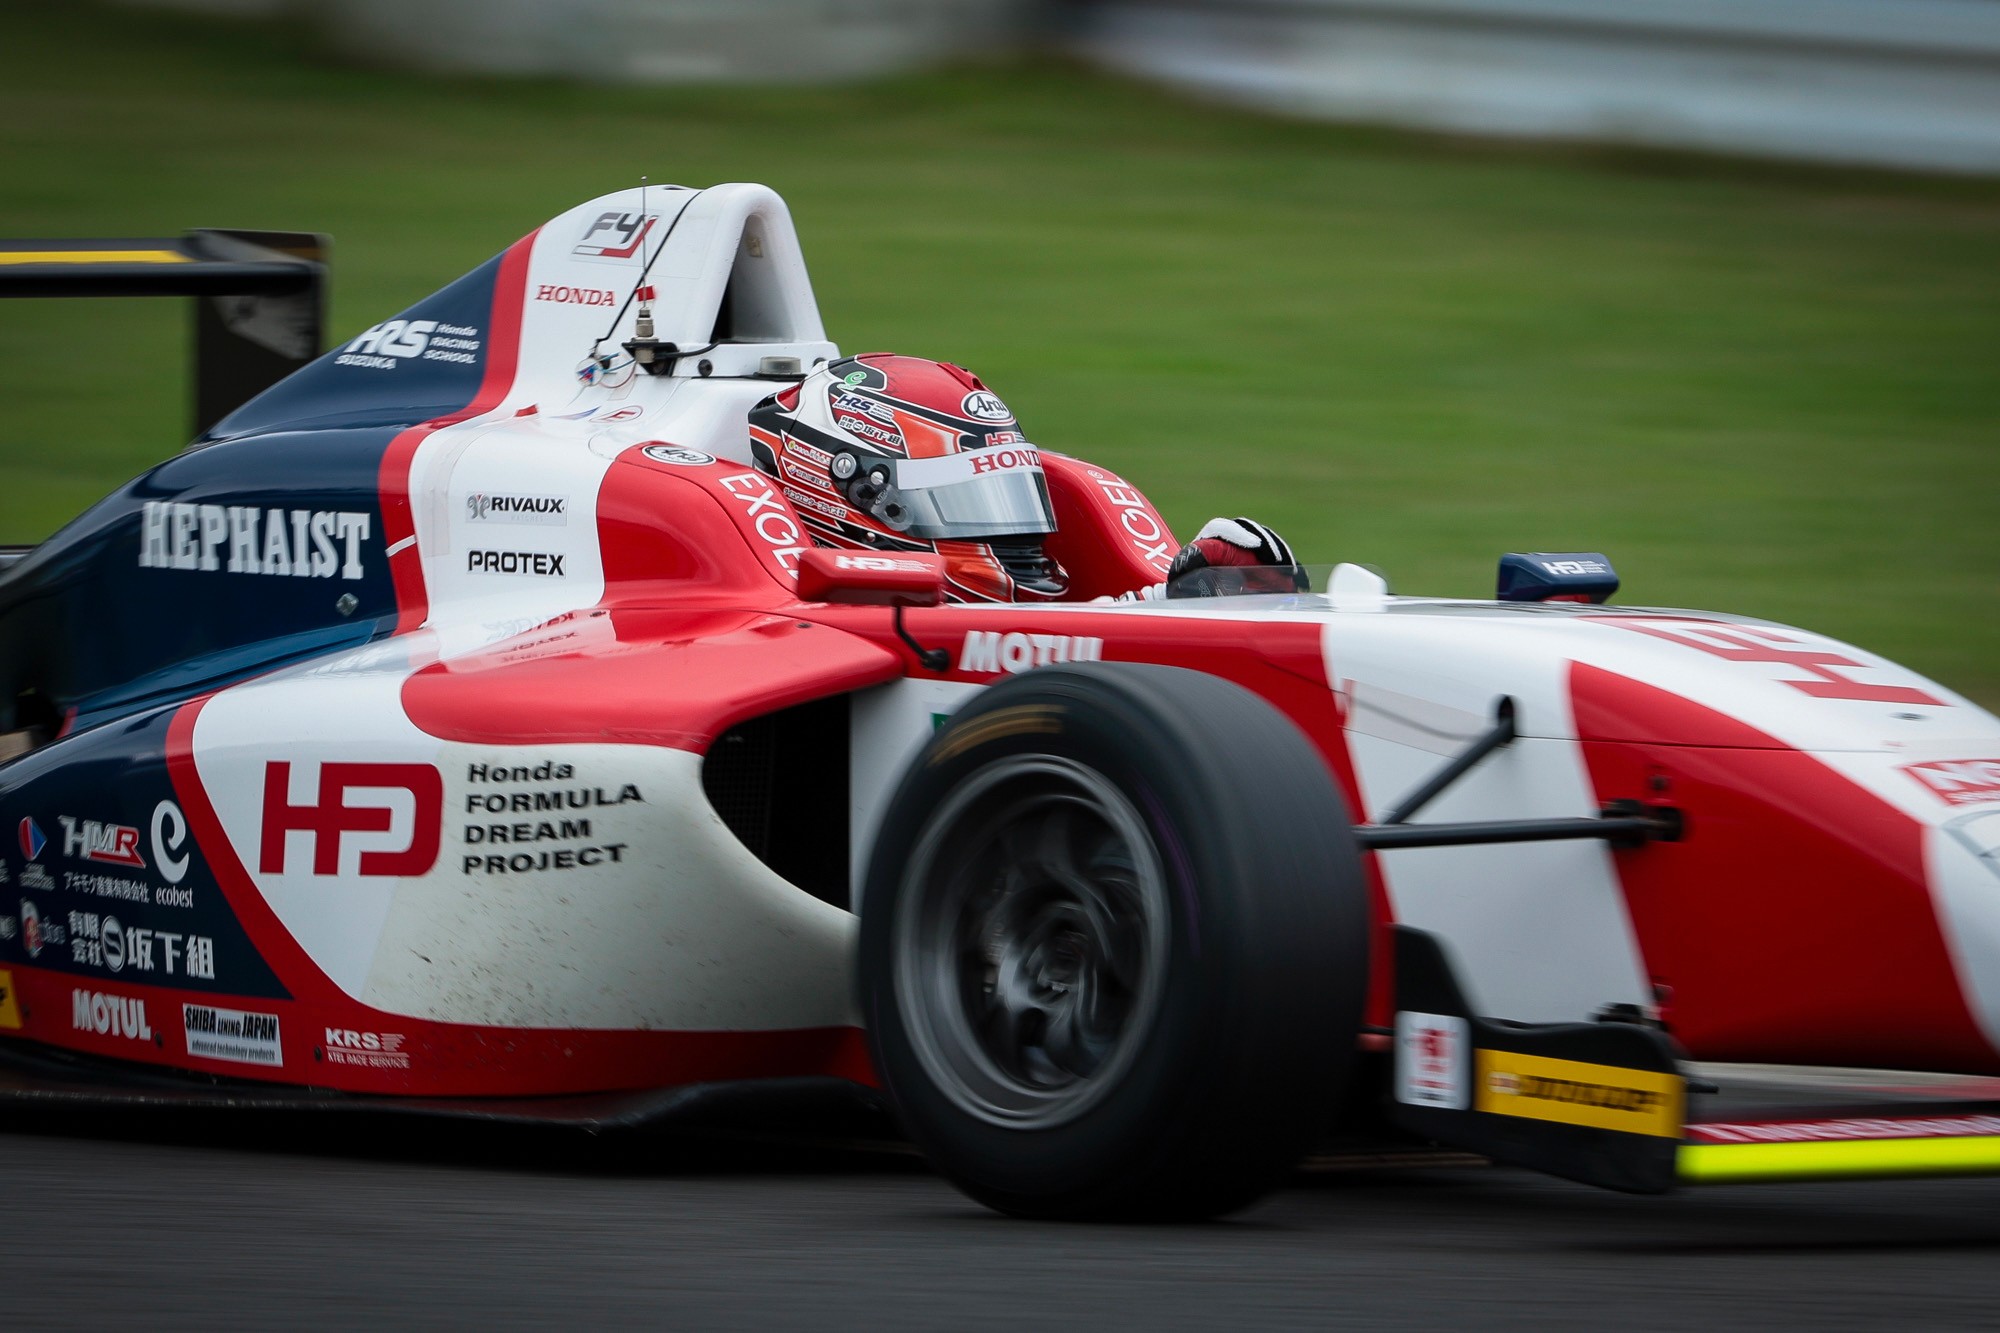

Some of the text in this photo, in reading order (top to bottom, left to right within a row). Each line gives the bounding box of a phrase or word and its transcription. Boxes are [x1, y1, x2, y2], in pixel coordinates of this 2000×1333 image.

[534, 284, 617, 307] HONDA
[343, 320, 439, 358] HRS
[435, 324, 478, 337] Honda
[423, 350, 477, 364] SCHOOL
[429, 337, 480, 351] RACING
[334, 354, 397, 370] SUZUKA
[969, 450, 1041, 475] HOND
[491, 496, 563, 514] RIVAUX
[138, 501, 370, 580] HEPHAIST
[468, 550, 565, 576] PROTEX
[958, 630, 1104, 675] MOTUL
[467, 760, 576, 783] Honda
[465, 784, 645, 814] FORMULA
[58, 814, 146, 869] HMR
[464, 819, 593, 845] DREAM
[463, 843, 628, 876] PROJECT
[156, 886, 193, 908] ecobest
[126, 926, 215, 979] 坂下組
[72, 988, 151, 1041] MOTUL
[185, 1005, 217, 1035] SHIBA
[242, 1013, 277, 1041] JAPAN
[325, 1027, 381, 1050] KRS
